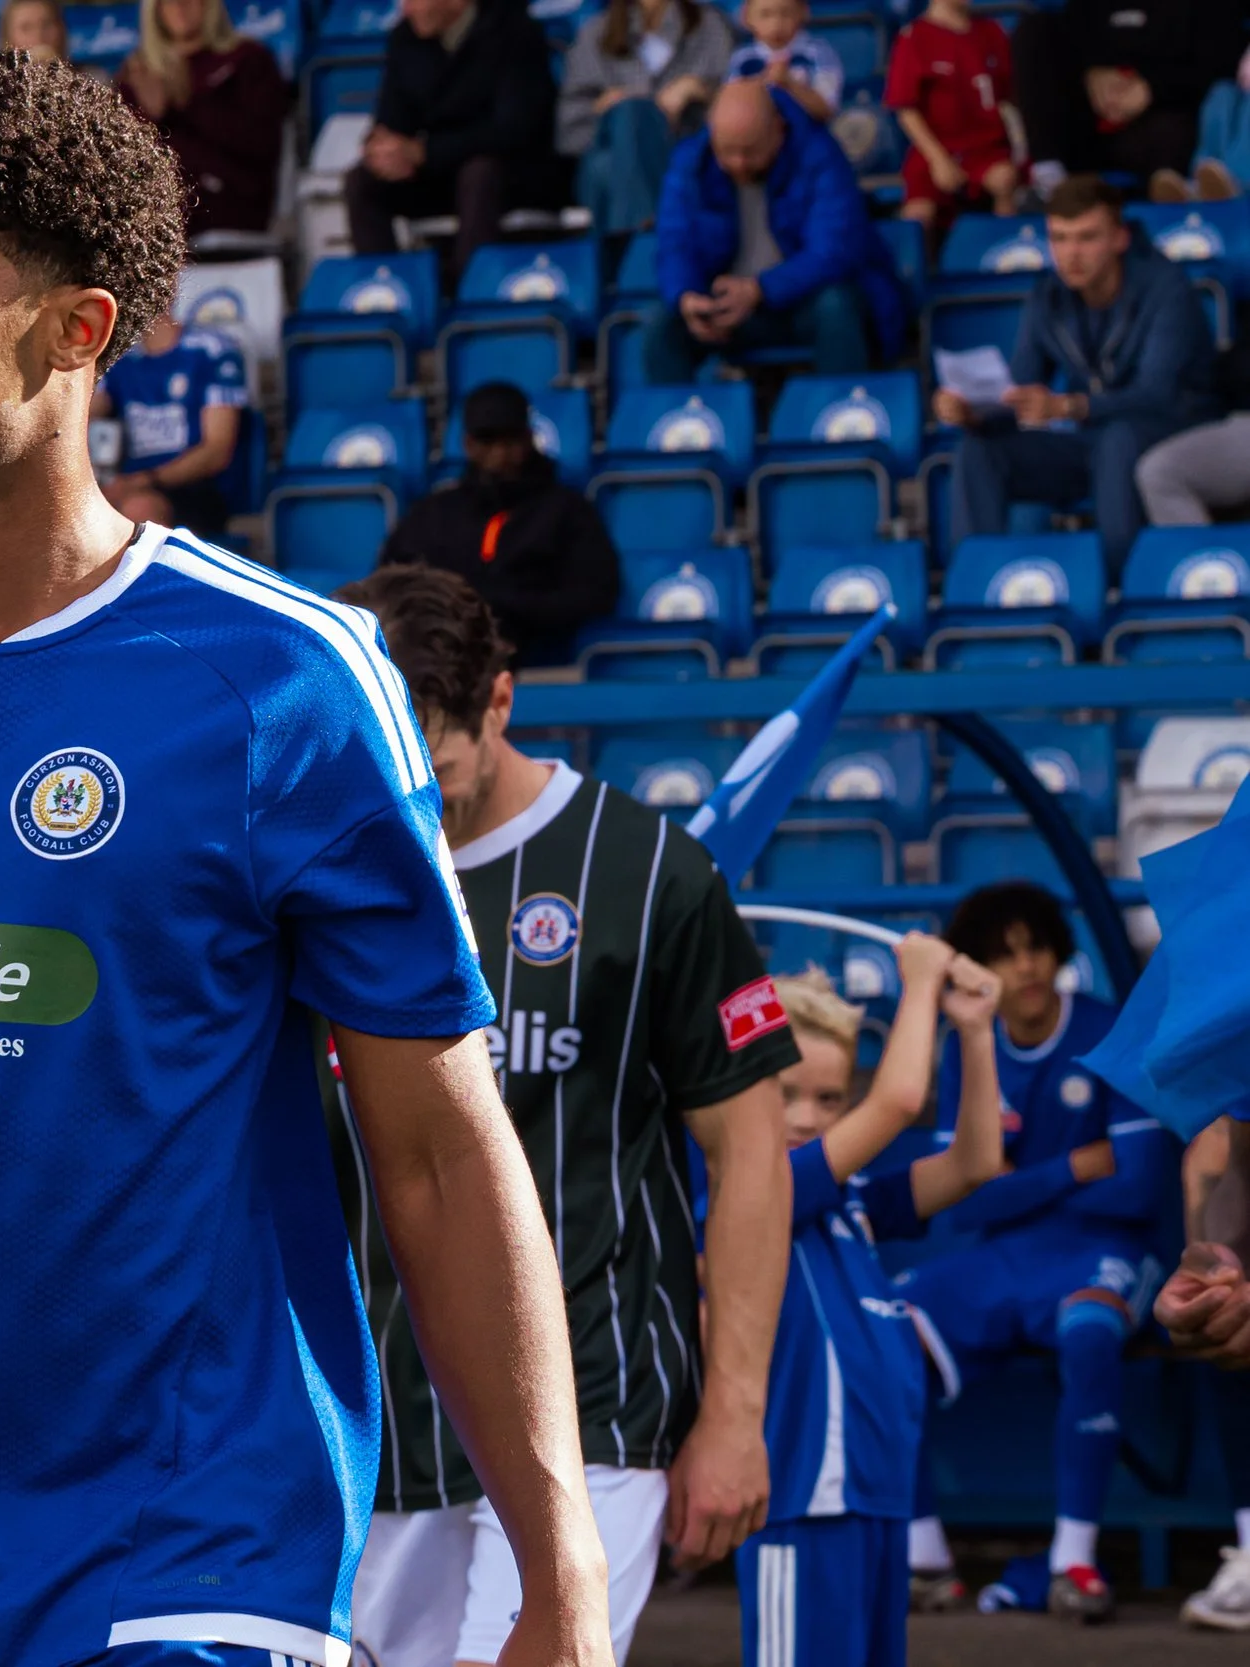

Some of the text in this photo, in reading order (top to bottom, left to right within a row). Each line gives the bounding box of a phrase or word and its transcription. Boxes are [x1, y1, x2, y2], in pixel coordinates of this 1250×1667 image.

[25, 754, 117, 793] CURZON ASHTON
[19, 813, 110, 850] FOOTBALL CLUB
